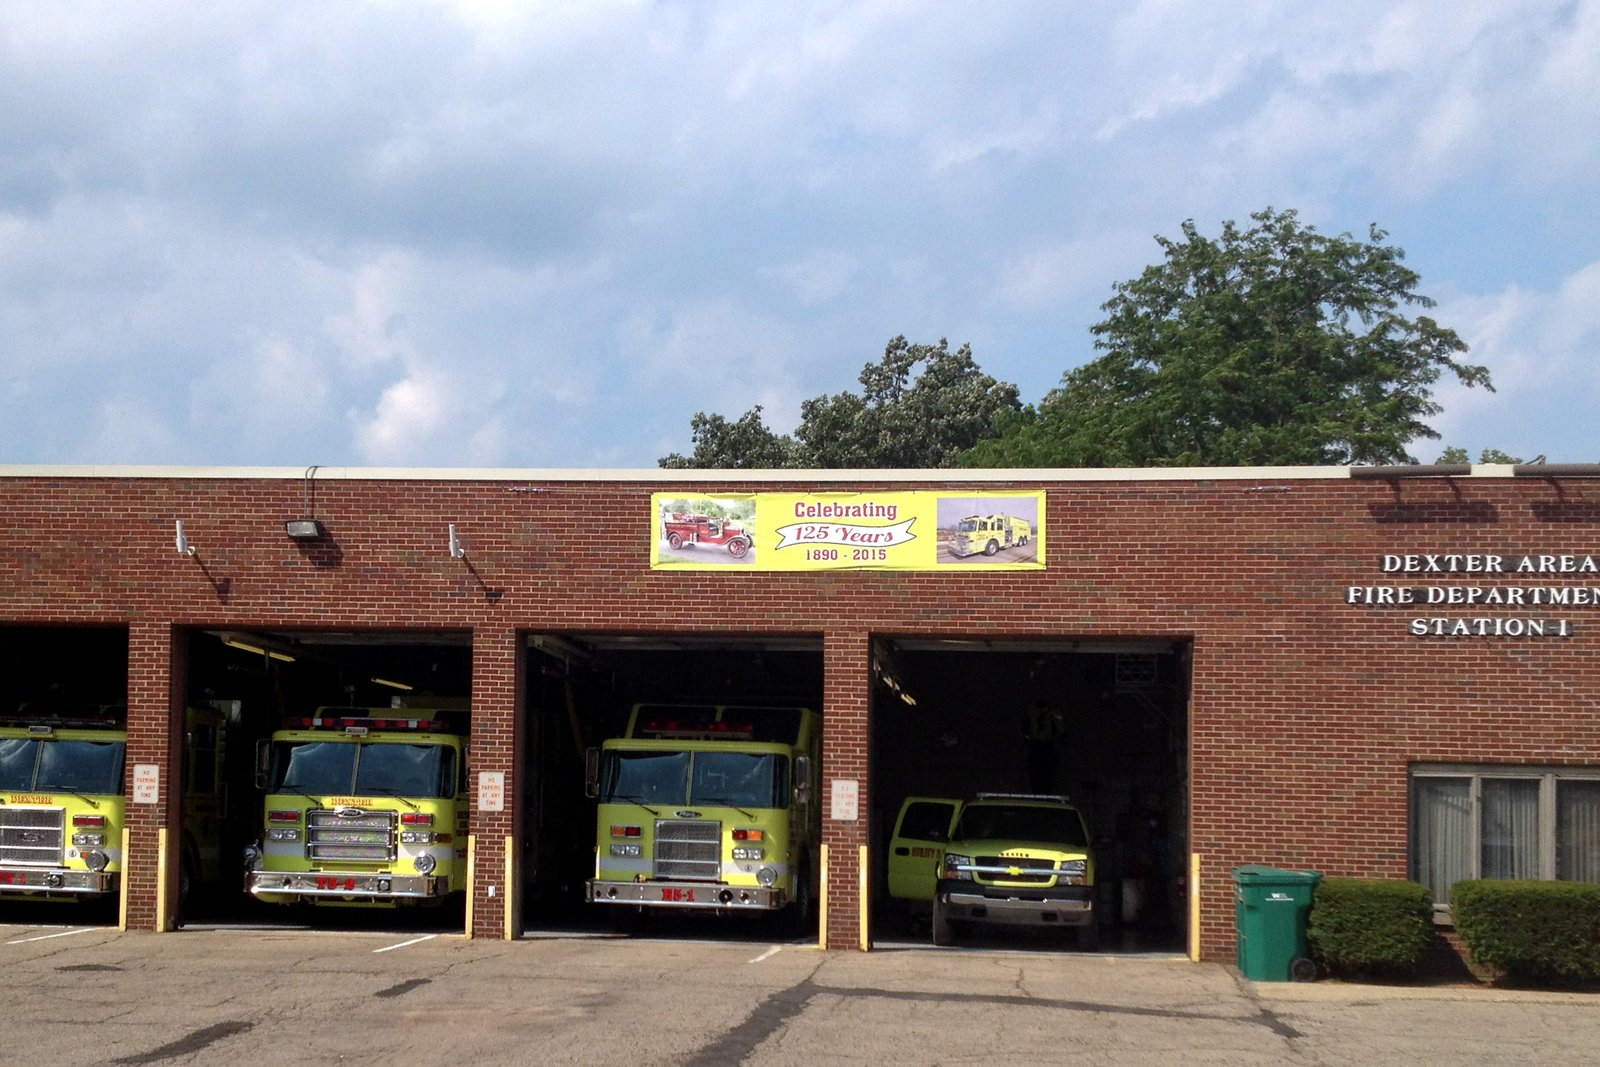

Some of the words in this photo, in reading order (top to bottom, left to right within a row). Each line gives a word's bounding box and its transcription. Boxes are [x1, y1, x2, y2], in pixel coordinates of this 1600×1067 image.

[795, 502, 897, 521] Celebrating
[795, 526, 830, 541] 125
[835, 527, 894, 543] Years
[806, 549, 838, 561] 1890
[852, 549, 887, 561] 2015
[1383, 554, 1503, 572] DEXTER
[1516, 554, 1598, 572] AREA
[1348, 586, 1414, 604] FIRE
